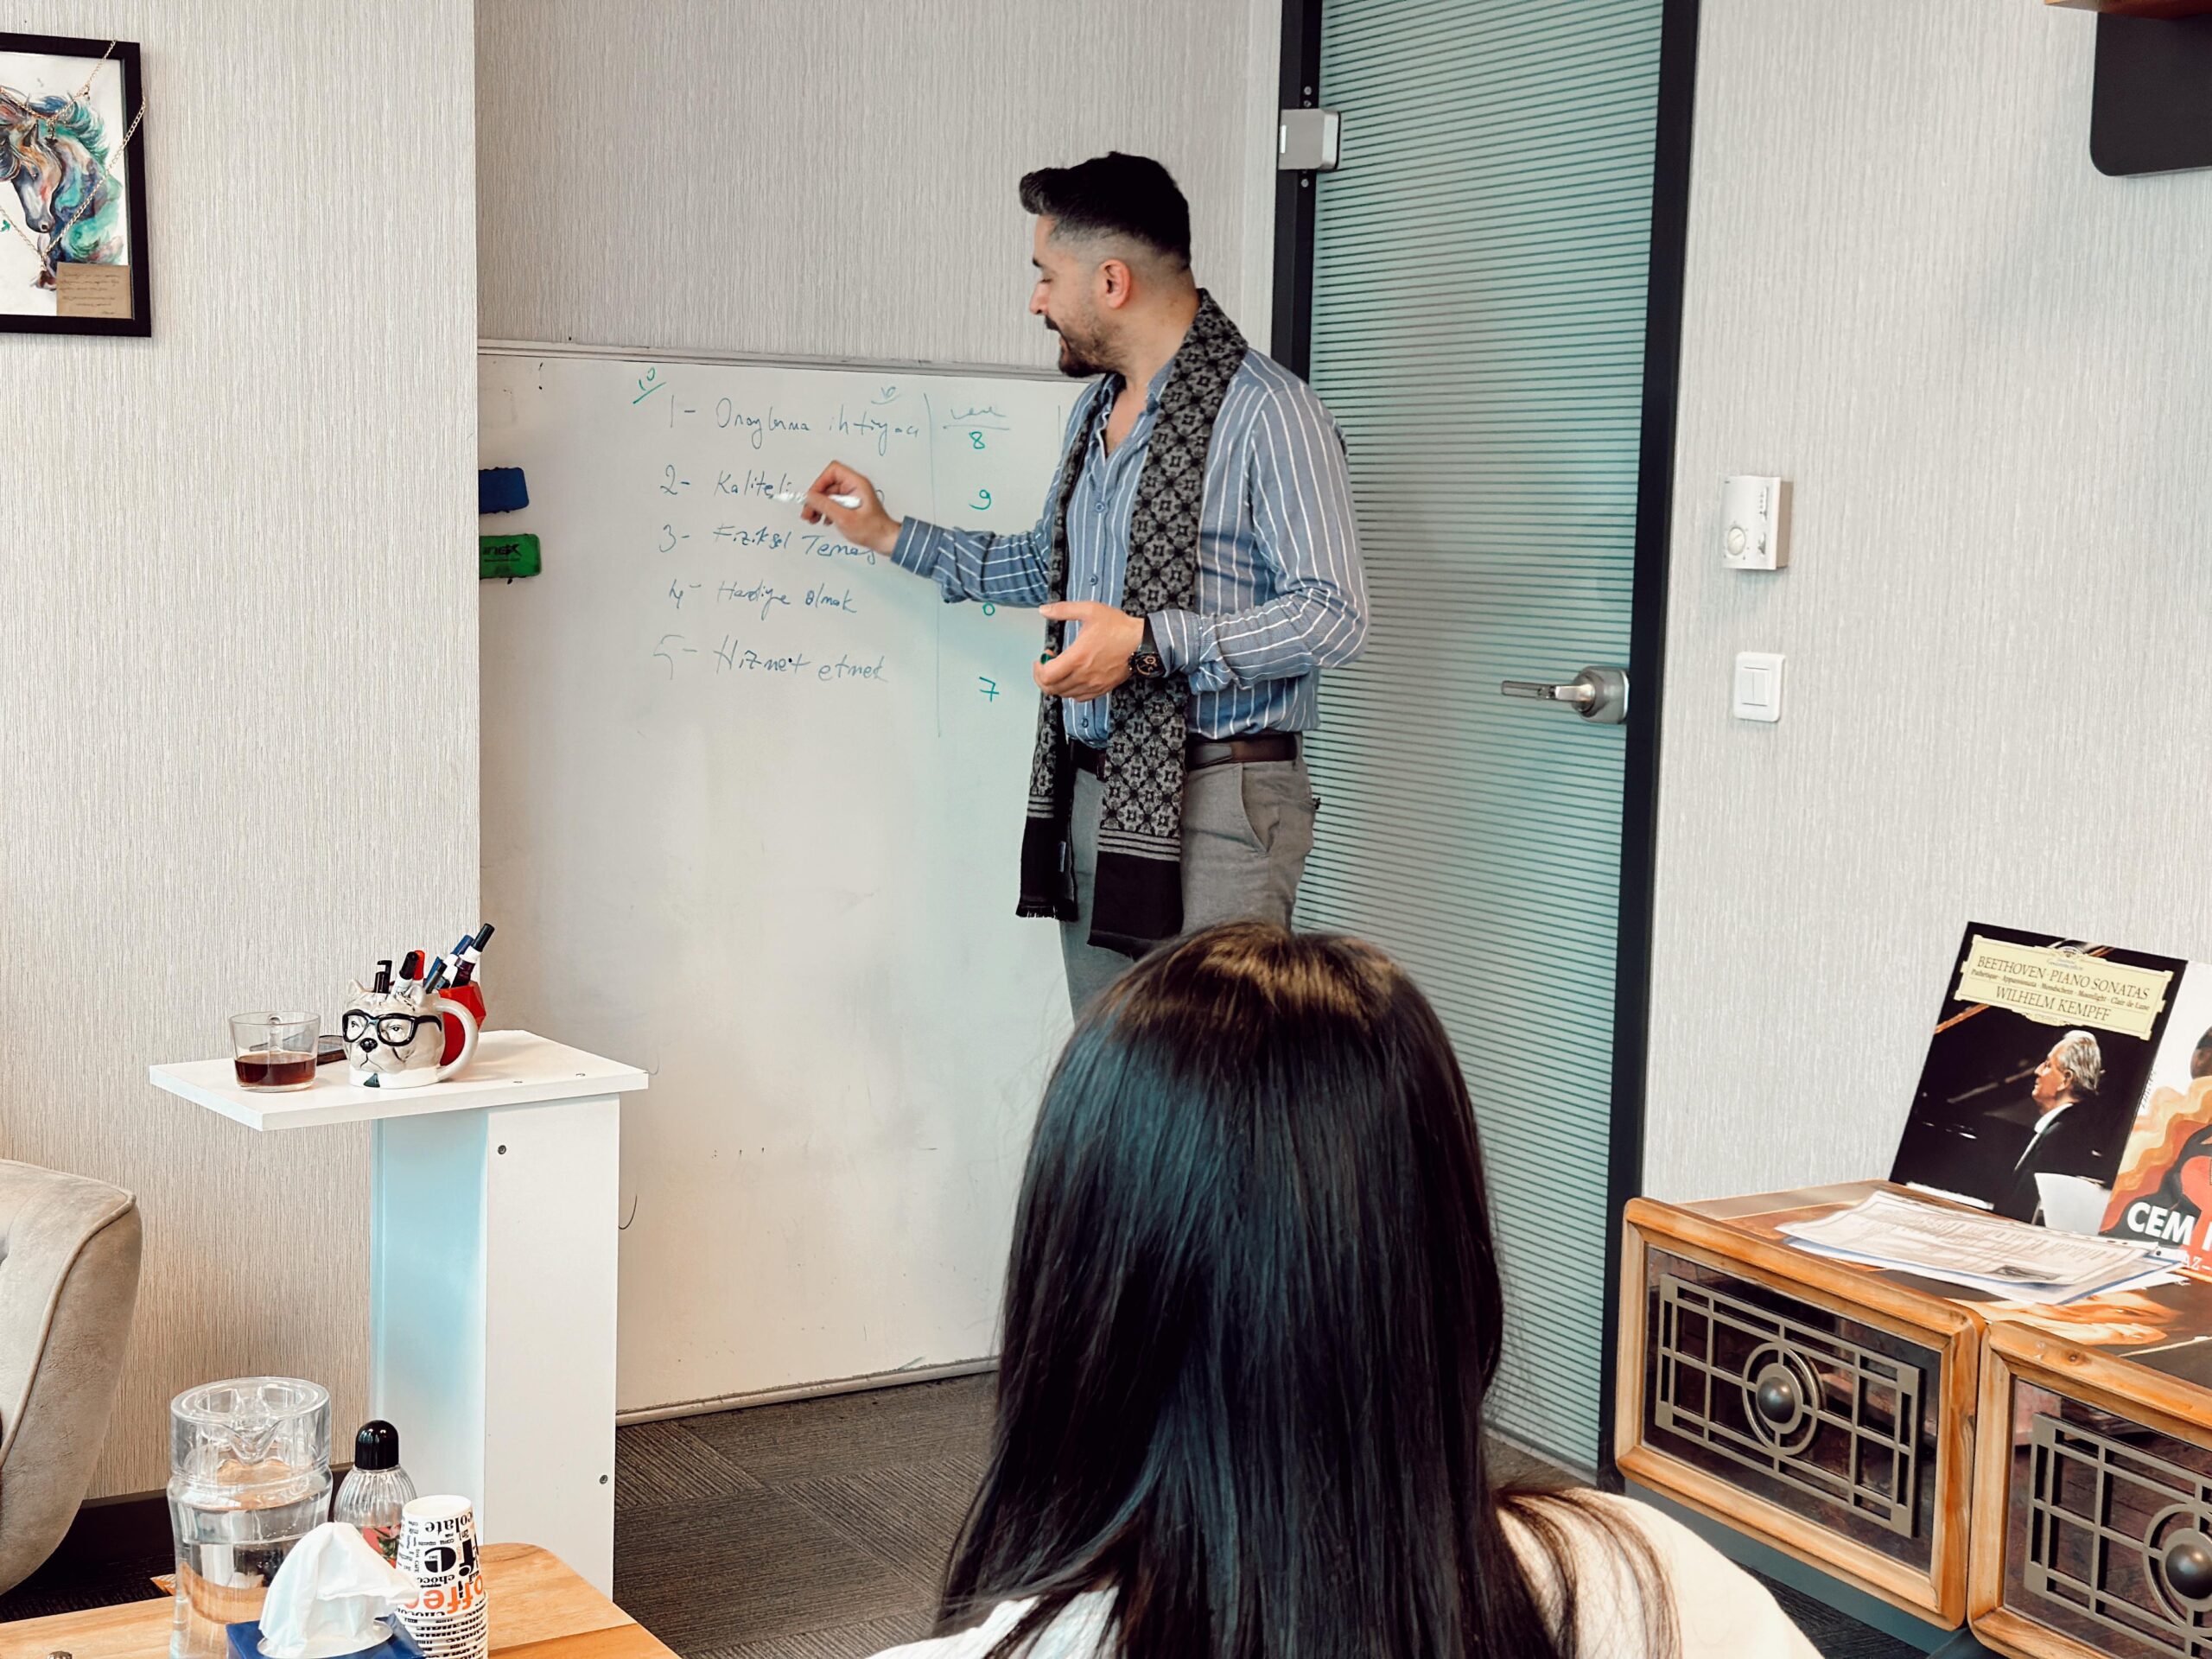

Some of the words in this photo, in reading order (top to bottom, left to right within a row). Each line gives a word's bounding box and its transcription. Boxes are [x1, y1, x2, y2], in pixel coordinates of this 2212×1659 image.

[969, 431, 986, 449] 8
[969, 489, 992, 511] 9
[979, 676, 1000, 702] 7
[1977, 956, 2046, 978] BEETHOVEN
[2050, 969, 2090, 988] PIANO
[2088, 978, 2151, 1000] SONATAS
[1995, 986, 2056, 1010] WILHELM
[2057, 997, 2112, 1021] KEMPFF
[2127, 1202, 2196, 1246] CEM
